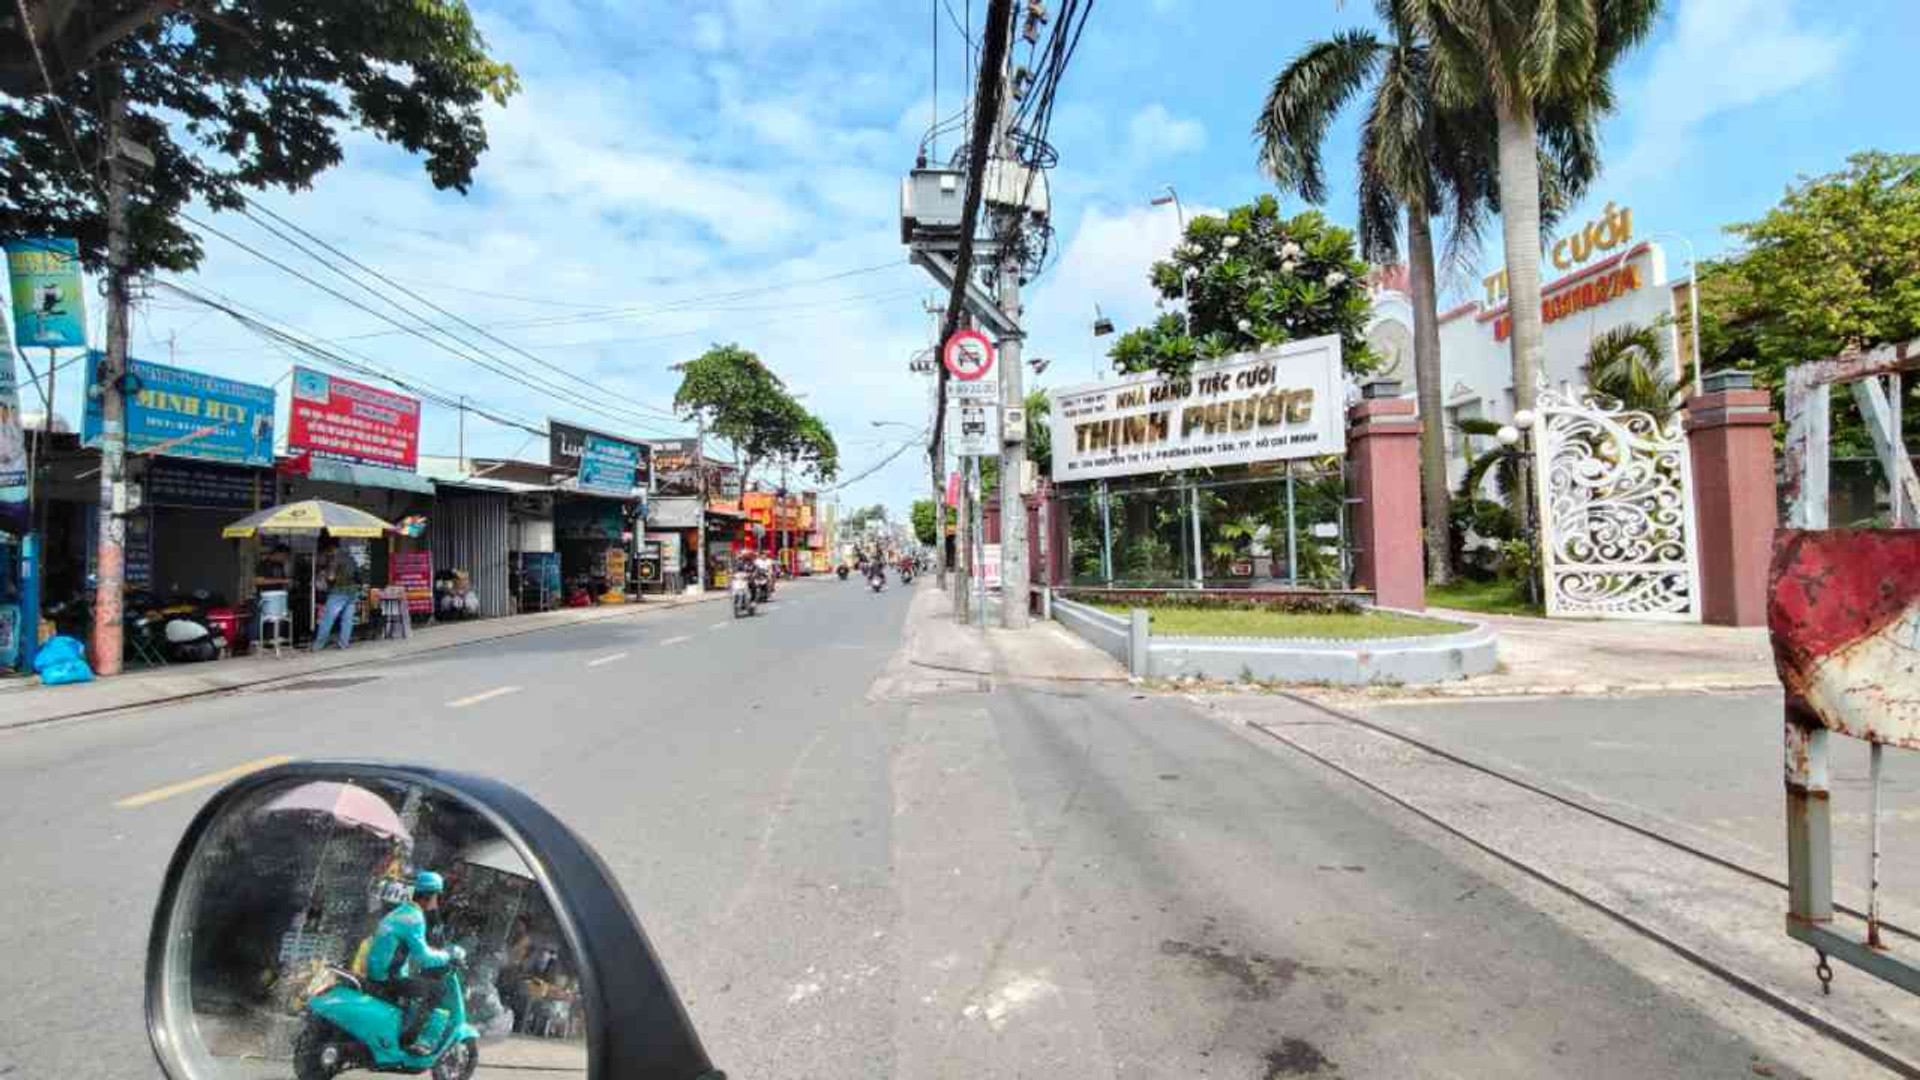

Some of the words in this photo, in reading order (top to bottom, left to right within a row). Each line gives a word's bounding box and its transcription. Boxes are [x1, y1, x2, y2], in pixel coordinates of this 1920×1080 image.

[1115, 386, 1145, 411] NHÀ
[1149, 380, 1192, 404] HÀNG
[1199, 371, 1231, 396] TIỆC
[1237, 363, 1276, 388] CƯỚI
[1074, 411, 1169, 453] THỊNH
[1181, 387, 1314, 437] PHƯỚC
